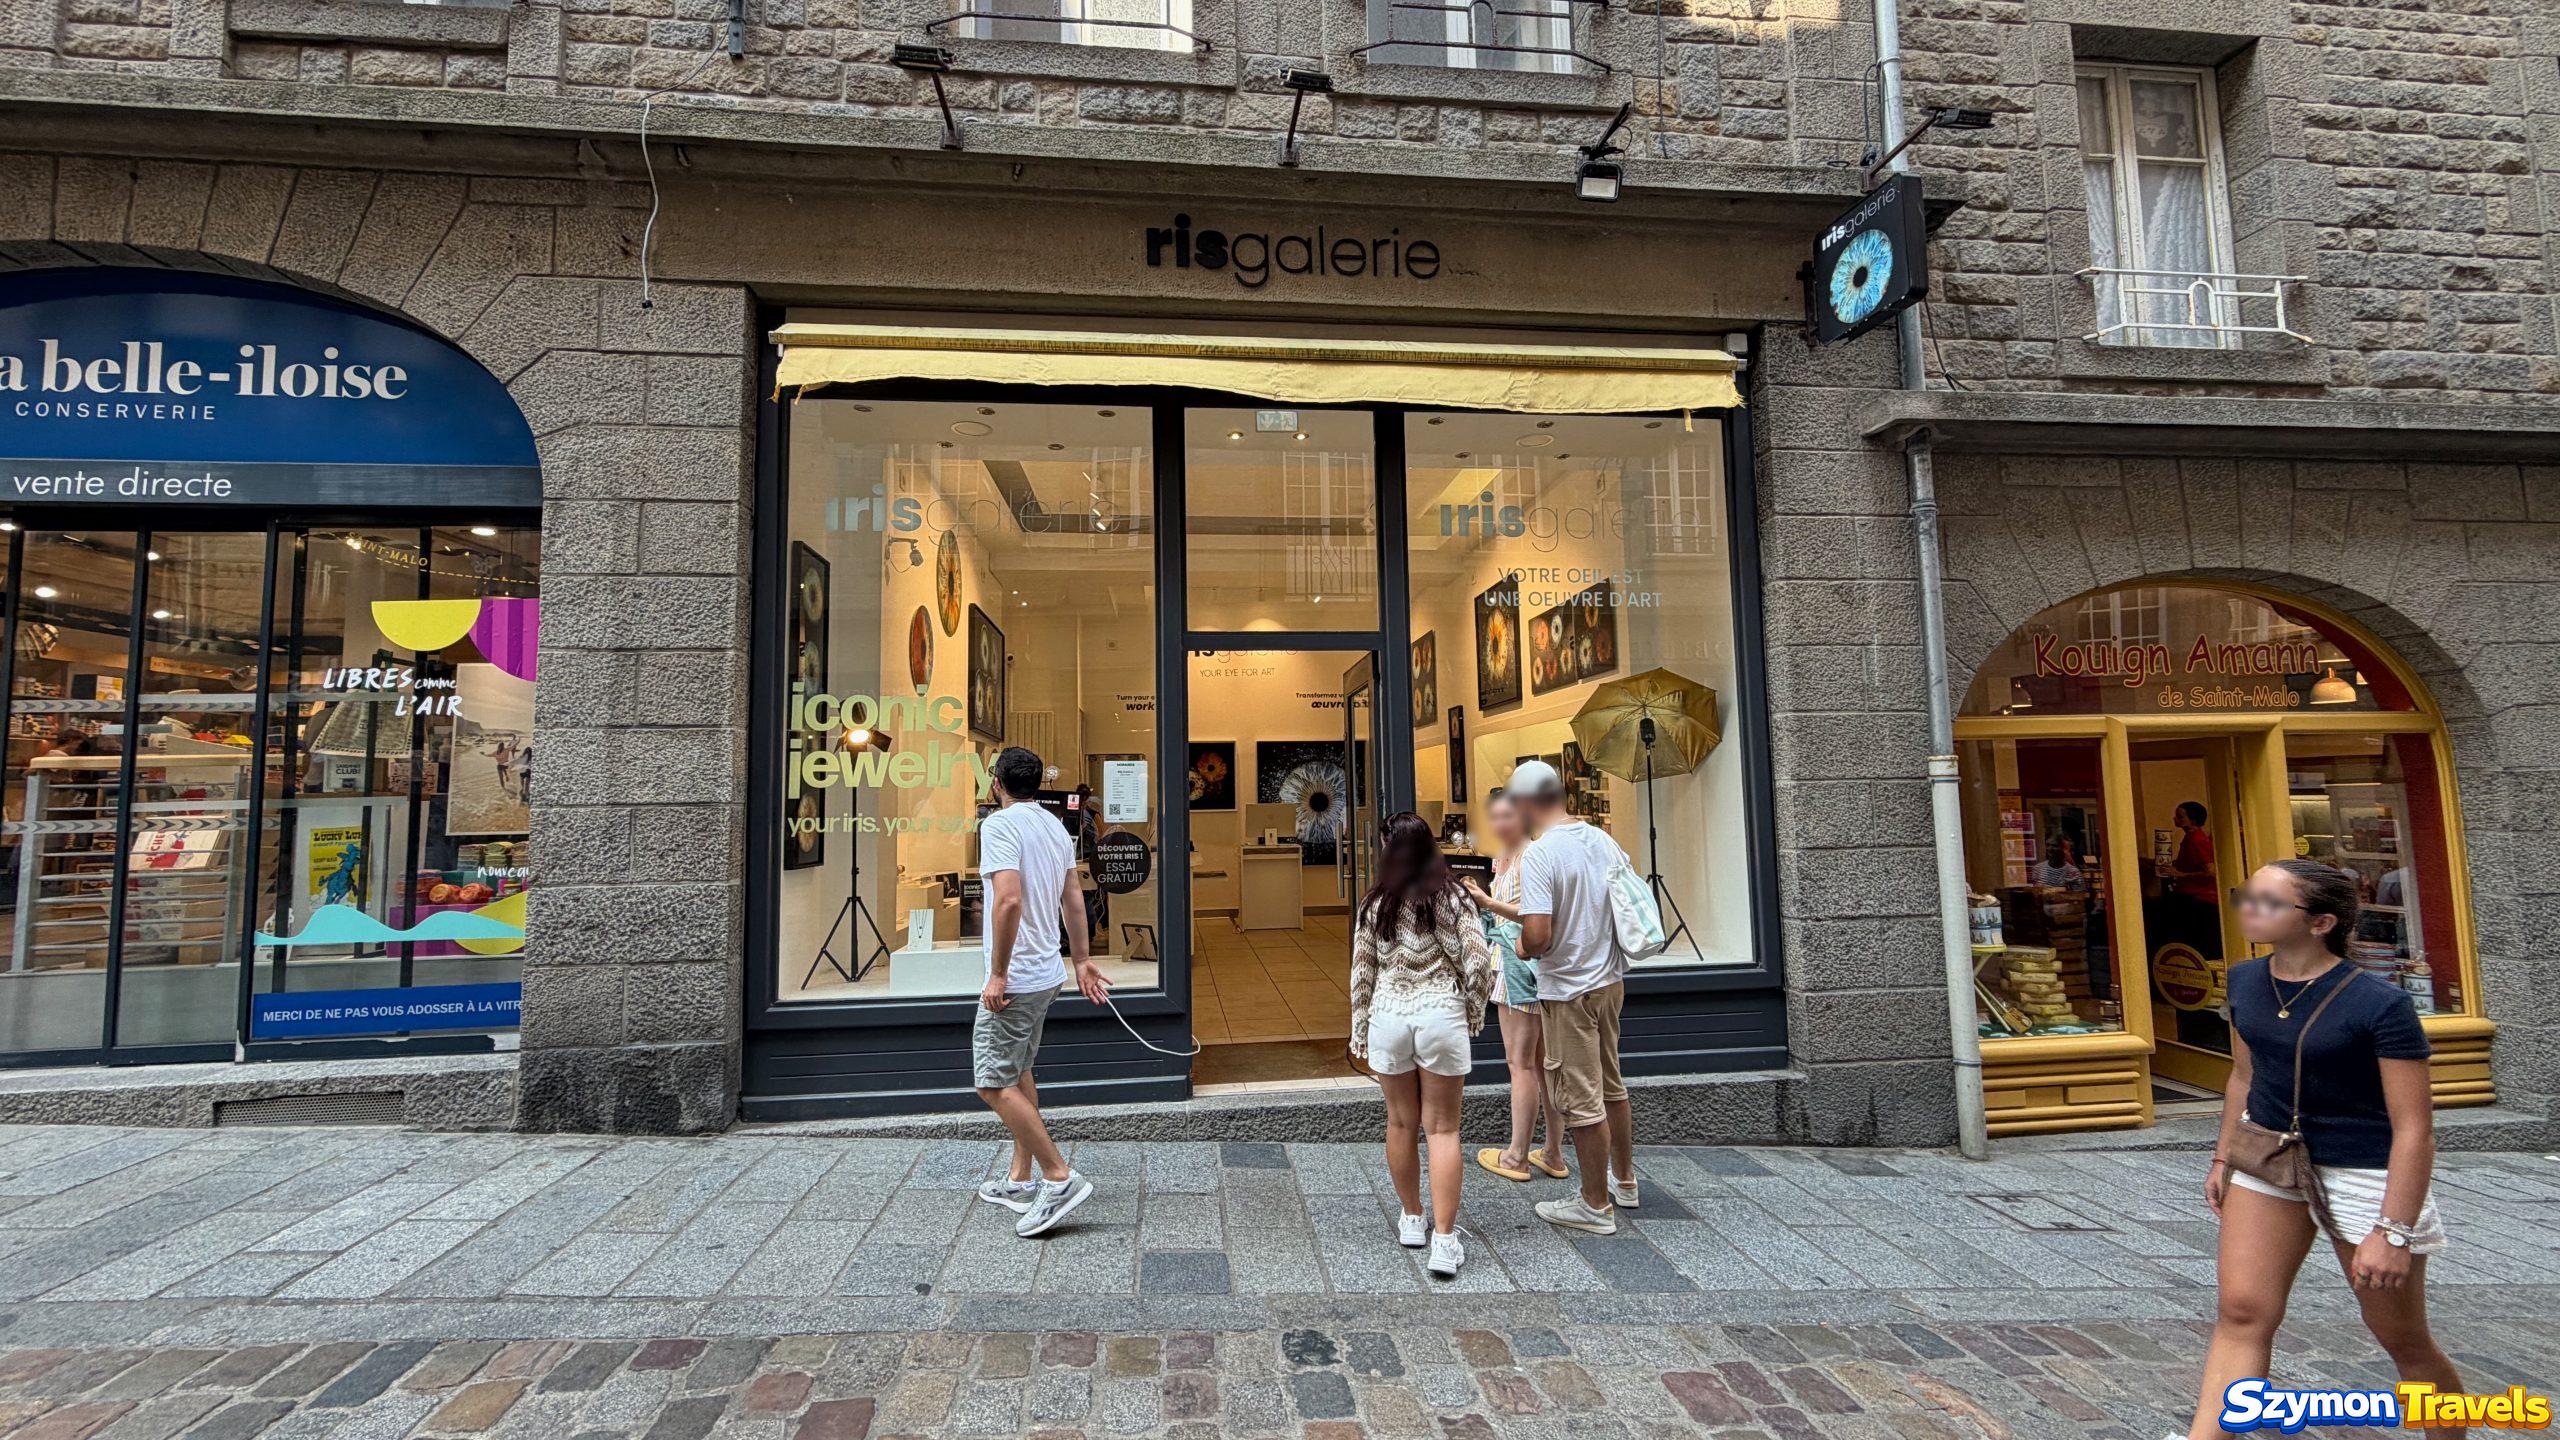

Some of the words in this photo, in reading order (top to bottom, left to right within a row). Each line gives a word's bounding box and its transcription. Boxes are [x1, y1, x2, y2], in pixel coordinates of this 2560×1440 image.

[1146, 213, 1440, 288] risgalerie
[0, 355, 28, 392] a
[38, 338, 408, 400] belle-iloise
[15, 401, 216, 420] CONSERVERIE
[13, 470, 105, 496] vente
[118, 467, 232, 497] directe
[1498, 567, 1561, 583] VOTRE
[1567, 568, 1606, 584] OEIL
[1612, 569, 1644, 584] EST
[1484, 590, 1521, 607] UNE
[1528, 591, 1608, 607] OEUVRE
[1609, 590, 1662, 608] D'ART
[2033, 633, 2172, 688] Kouign
[2185, 633, 2321, 675] Amann
[323, 667, 414, 690] LIBRES
[414, 677, 457, 690] comme
[1200, 669, 1222, 677] YOUR
[1225, 669, 1239, 677] EYE
[1241, 669, 1258, 677] FOR
[1261, 667, 1275, 676] ART
[395, 695, 463, 717] L'AIR
[791, 682, 964, 733] iconic
[1126, 701, 1155, 711] work
[2158, 685, 2185, 708] de
[2189, 685, 2300, 708] Saint-Malo
[788, 738, 1000, 800] jewelry
[788, 816, 840, 838] your
[843, 812, 881, 834] iris.
[883, 816, 930, 838] your
[939, 813, 985, 834] stor
[1097, 844, 1143, 852] DÉCOUVREZ
[1097, 873, 1144, 883] GRATUIT
[1106, 862, 1136, 872] ESSAI
[263, 1010, 302, 1022] MERCI
[305, 1009, 322, 1020] DE
[325, 1008, 341, 1019] NE
[344, 1007, 369, 1018] PAS
[372, 1005, 404, 1017] VOUS
[406, 1003, 463, 1015] ADOSSER
[466, 1000, 475, 1012] À
[478, 1001, 493, 1011] LA
[497, 1000, 521, 1010] VITR
